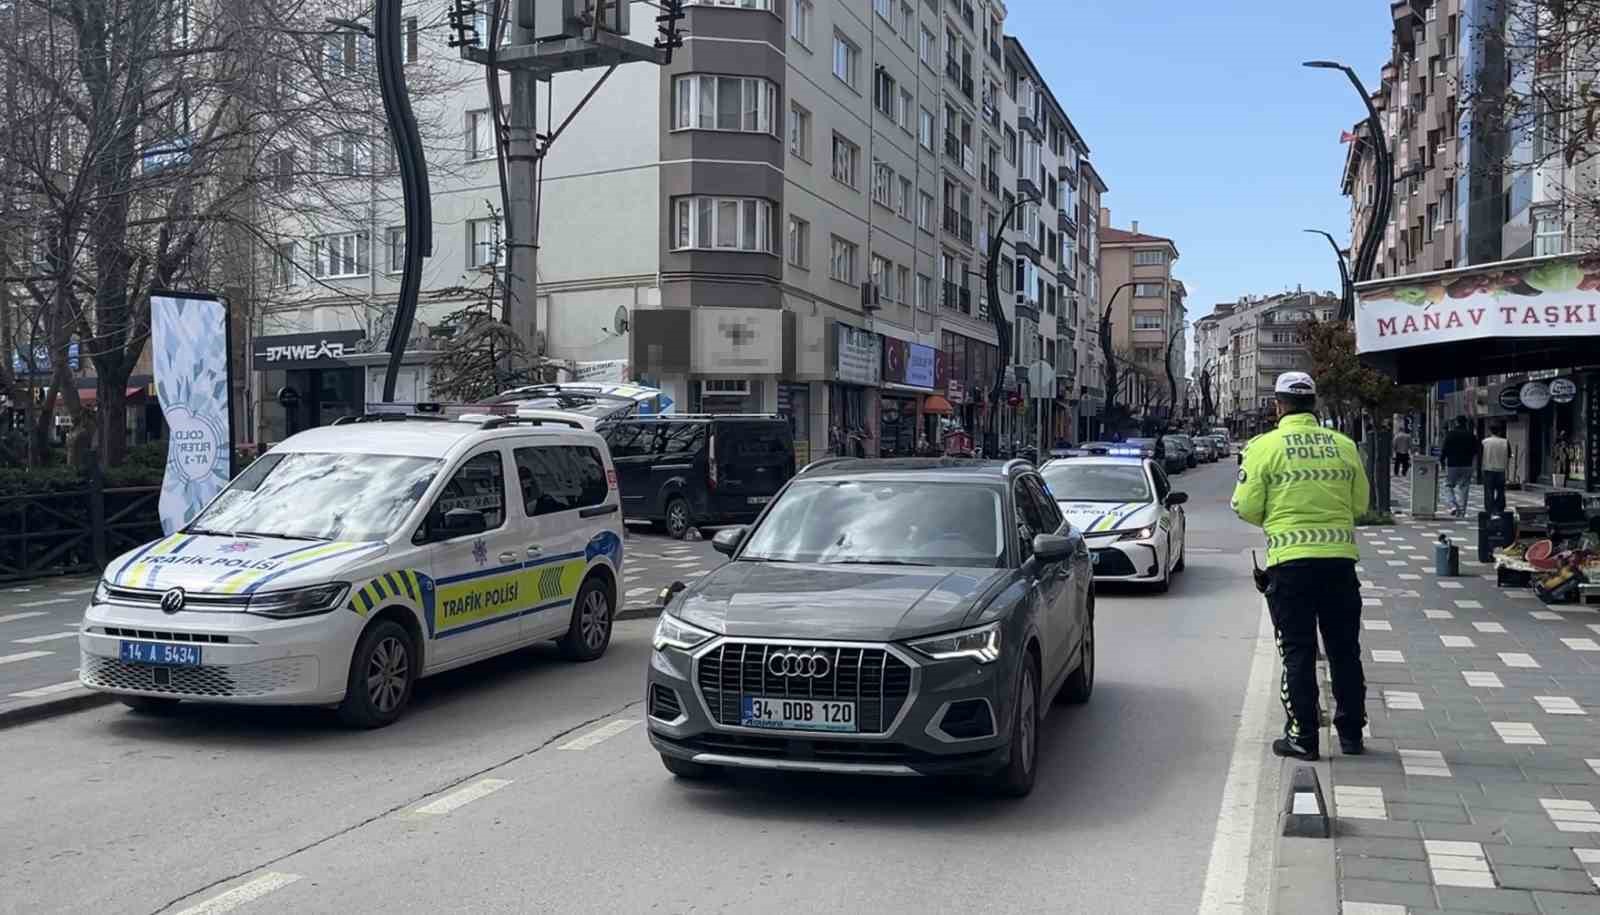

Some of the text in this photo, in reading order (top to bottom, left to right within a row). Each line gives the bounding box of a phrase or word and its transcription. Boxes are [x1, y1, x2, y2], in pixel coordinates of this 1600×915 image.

[1377, 303, 1597, 337] MANAV TAŞKI
[140, 555, 283, 570] TRAFİK POLİSİ
[443, 581, 518, 618] TRAFİK POLİSİ
[129, 644, 195, 664] 14 A 5434
[753, 700, 852, 723] 34 DDB 120
